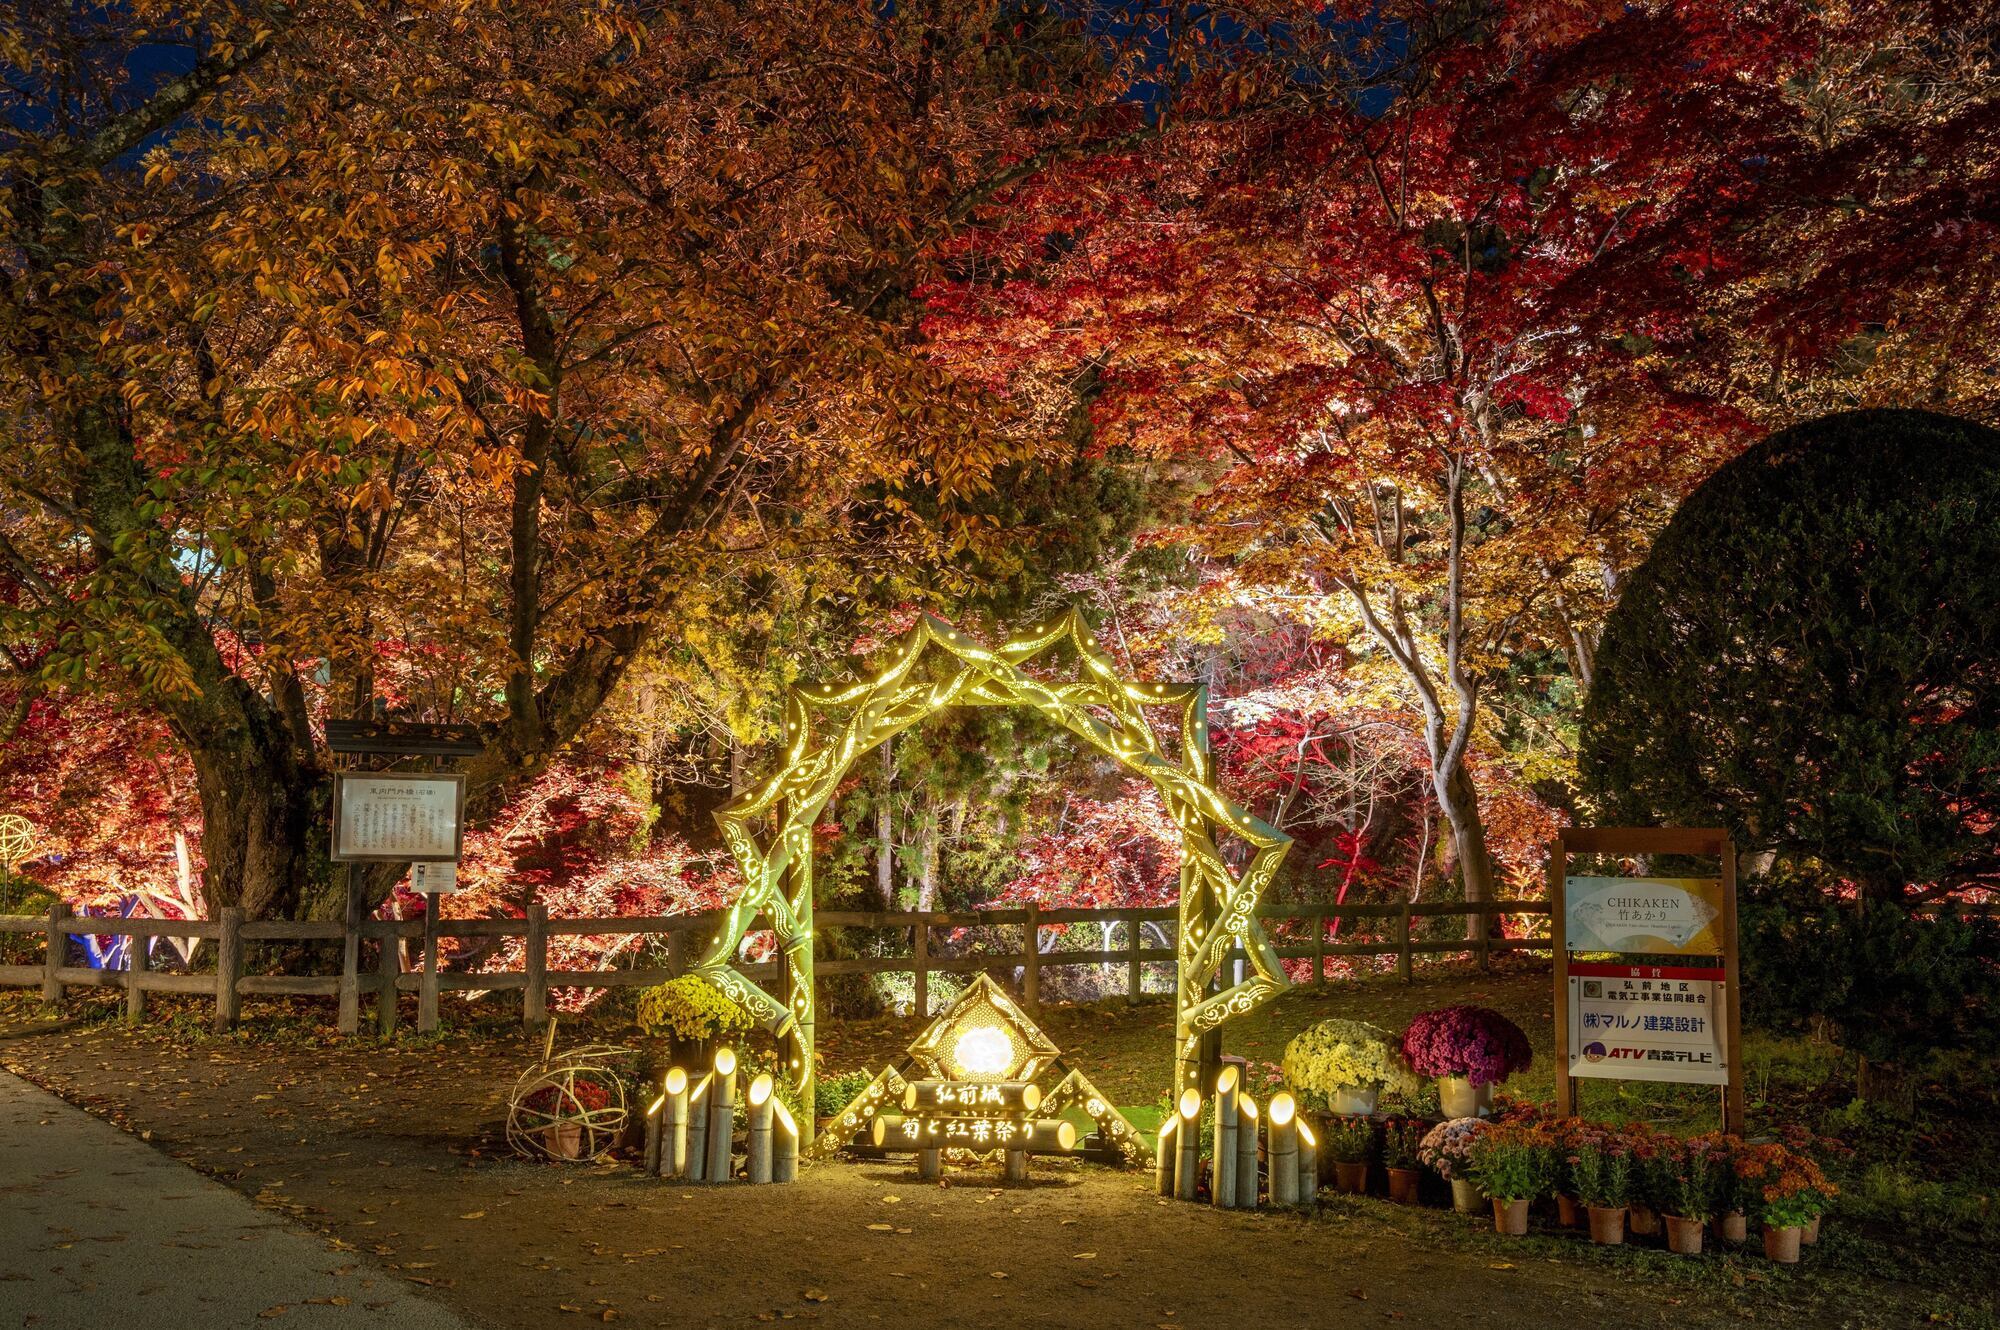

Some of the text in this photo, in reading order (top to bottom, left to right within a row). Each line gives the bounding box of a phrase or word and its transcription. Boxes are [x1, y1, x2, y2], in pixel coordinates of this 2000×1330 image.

[1607, 897, 1680, 909] CHIKAKEN
[1618, 910, 1667, 921] 竹あかり
[1630, 967, 1661, 978] 協賛
[1607, 991, 1706, 1003] 電気工事業協同組合
[1608, 1048, 1646, 1060] ATV
[935, 1084, 1005, 1105] 弘前城
[902, 1117, 1034, 1142] 菊と紅葉祭り
